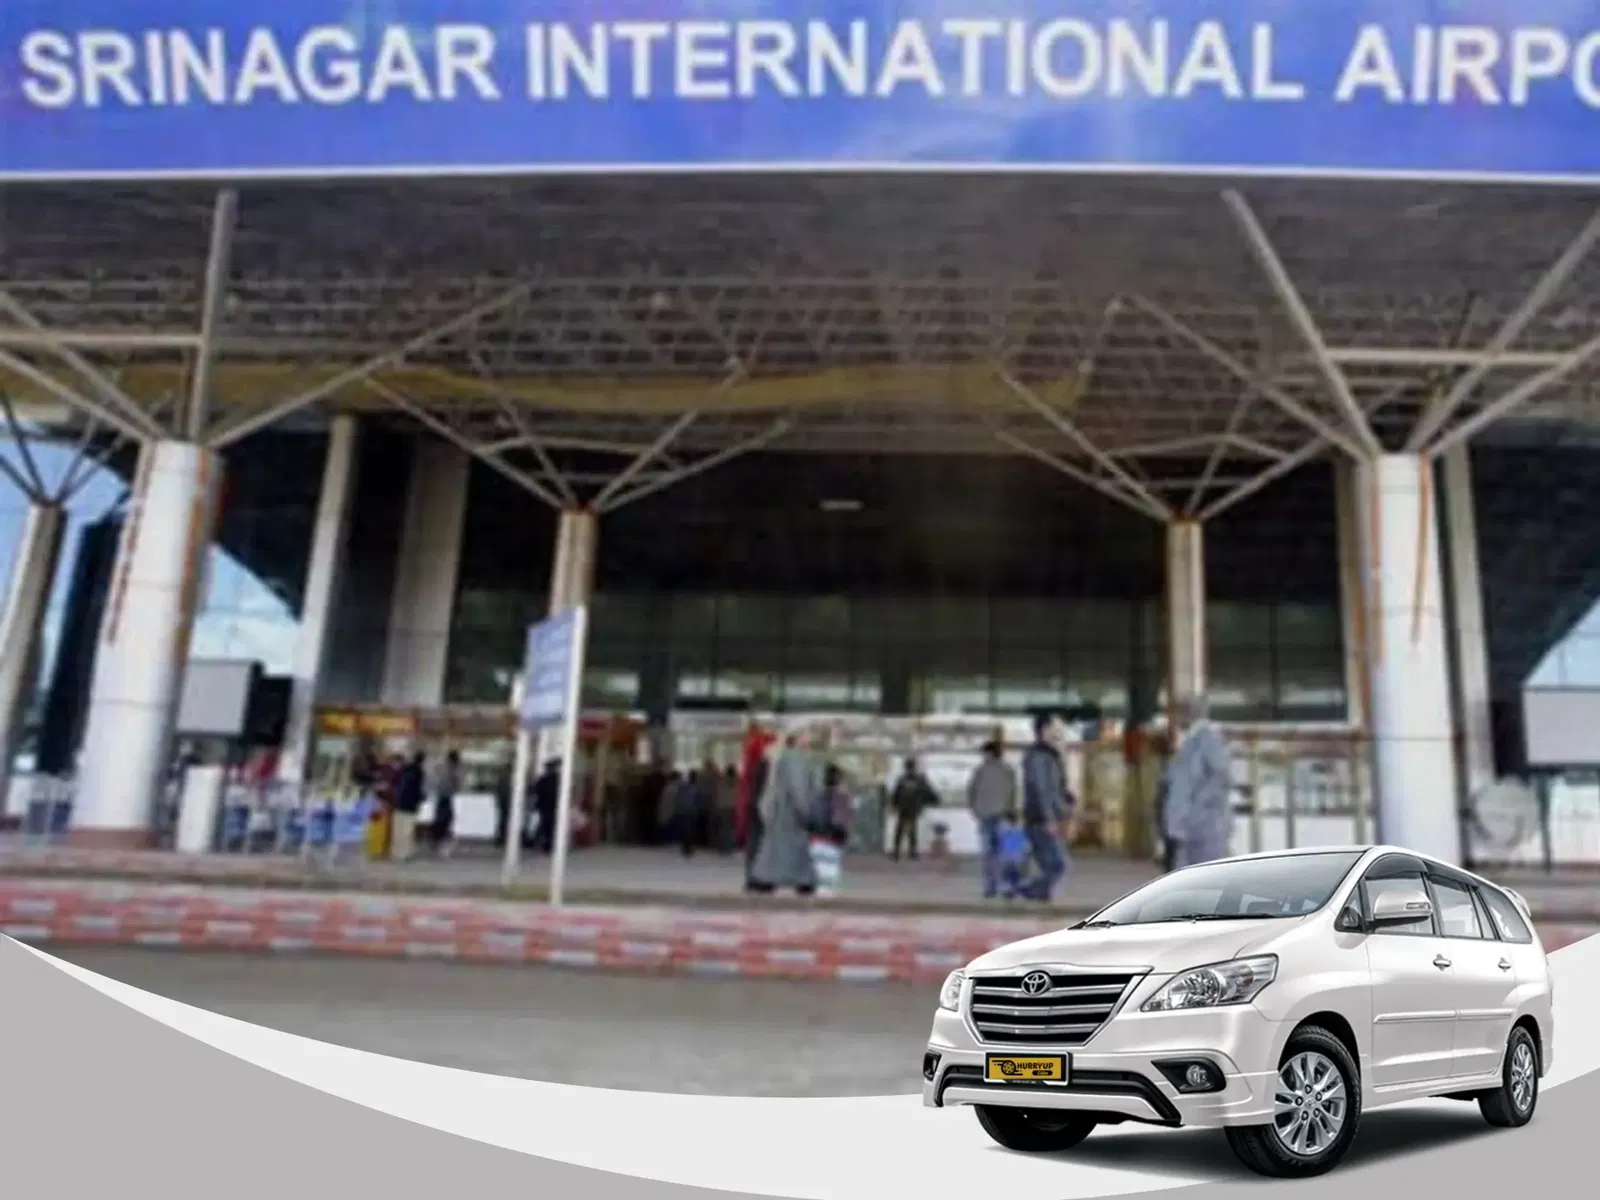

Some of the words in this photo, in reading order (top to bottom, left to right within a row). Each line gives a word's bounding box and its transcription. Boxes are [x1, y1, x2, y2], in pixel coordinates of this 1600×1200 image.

[22, 24, 499, 107] SRINAGAR
[526, 16, 1305, 102] INTERNATIONAL
[1017, 1062, 1054, 1070] HURRYUP
